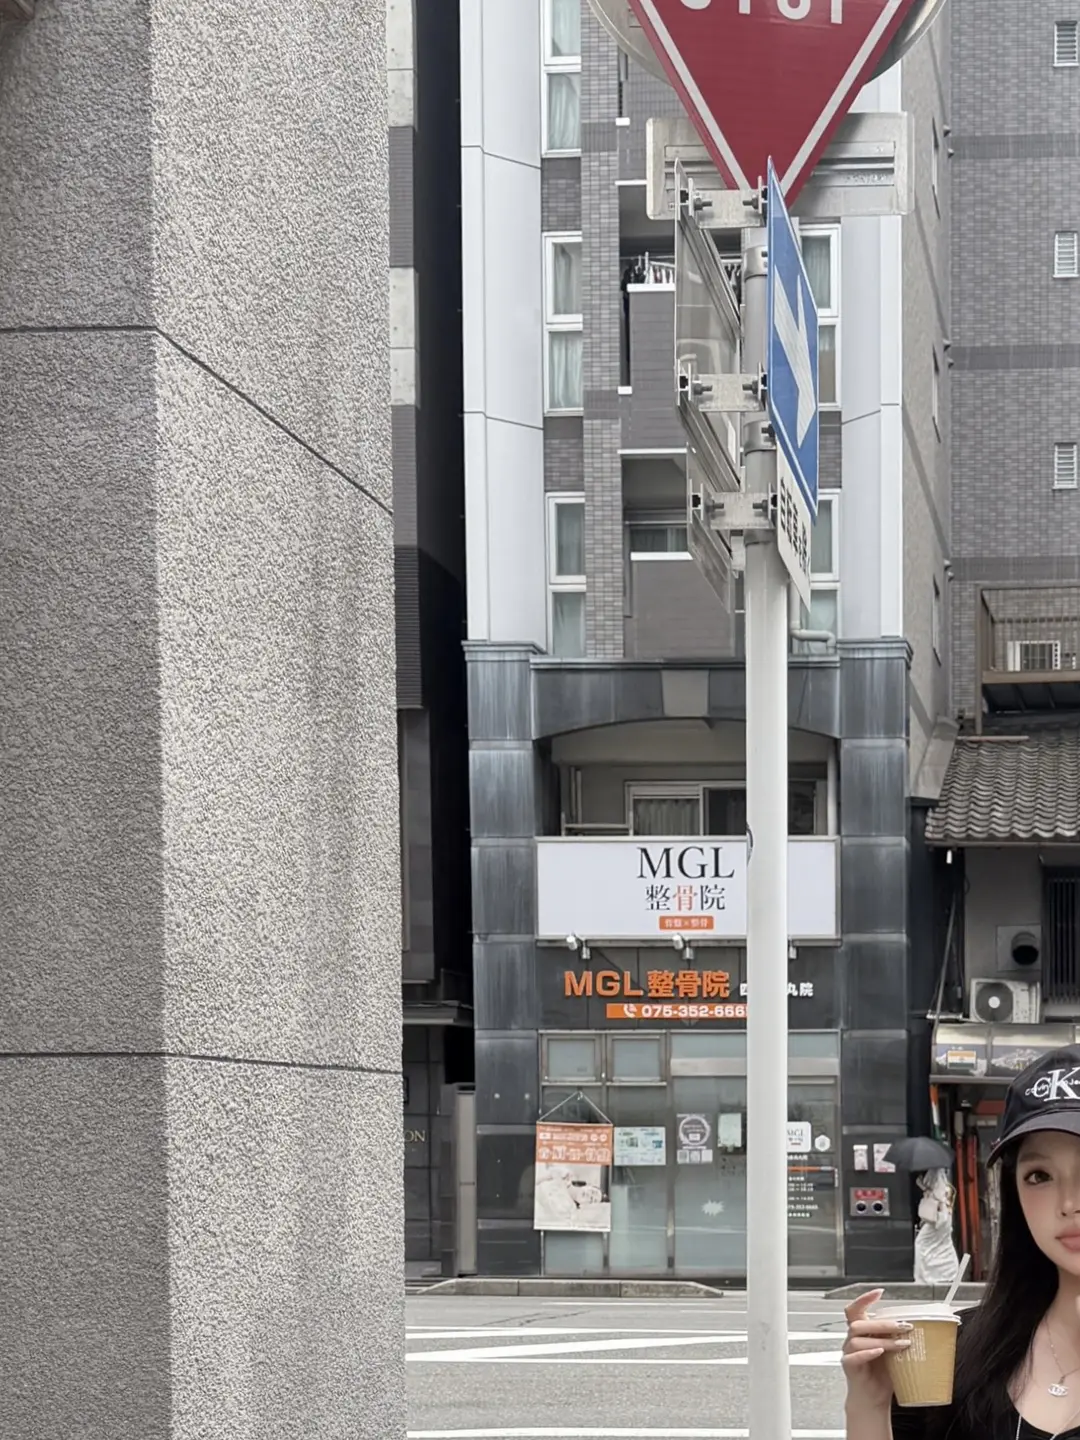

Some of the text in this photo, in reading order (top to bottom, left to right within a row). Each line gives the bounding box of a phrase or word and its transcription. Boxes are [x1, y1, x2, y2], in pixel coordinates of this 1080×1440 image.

[636, 846, 735, 879] MGL
[646, 884, 726, 911] 整骨院
[641, 1004, 748, 1018] 075-352-666
